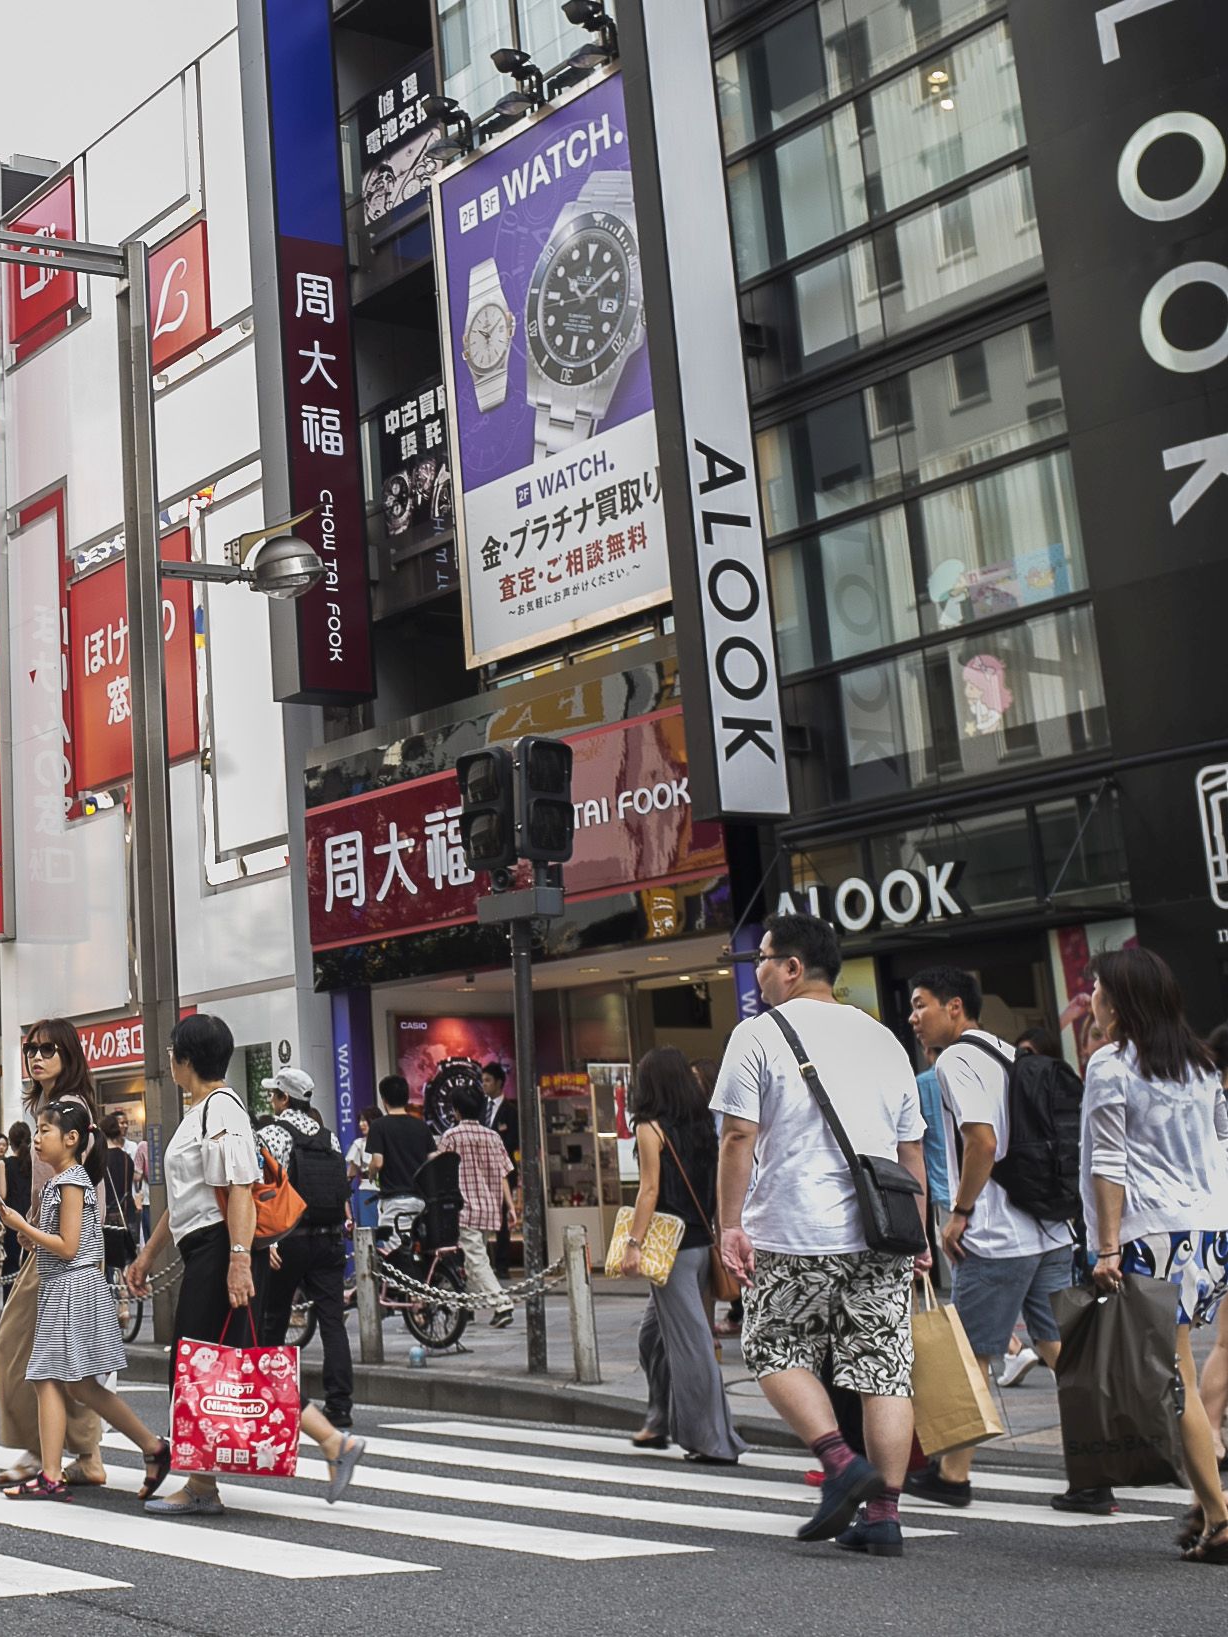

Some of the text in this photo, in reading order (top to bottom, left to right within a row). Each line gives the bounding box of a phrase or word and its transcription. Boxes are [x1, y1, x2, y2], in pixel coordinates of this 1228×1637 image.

[461, 113, 624, 227] 2F 3F WATCH.
[295, 272, 344, 456] 周大福
[536, 451, 615, 500] WATCH.
[319, 489, 343, 662] CHOW TAI FOOK
[499, 522, 648, 602] 査定・ご相談無料
[694, 438, 776, 764] ALOOK
[618, 777, 691, 820] FOOK
[777, 861, 962, 933] ALOOK
[400, 1021, 428, 1030] CASIO
[338, 1043, 353, 1132] WATCH.
[206, 1400, 262, 1414] Nintendo
